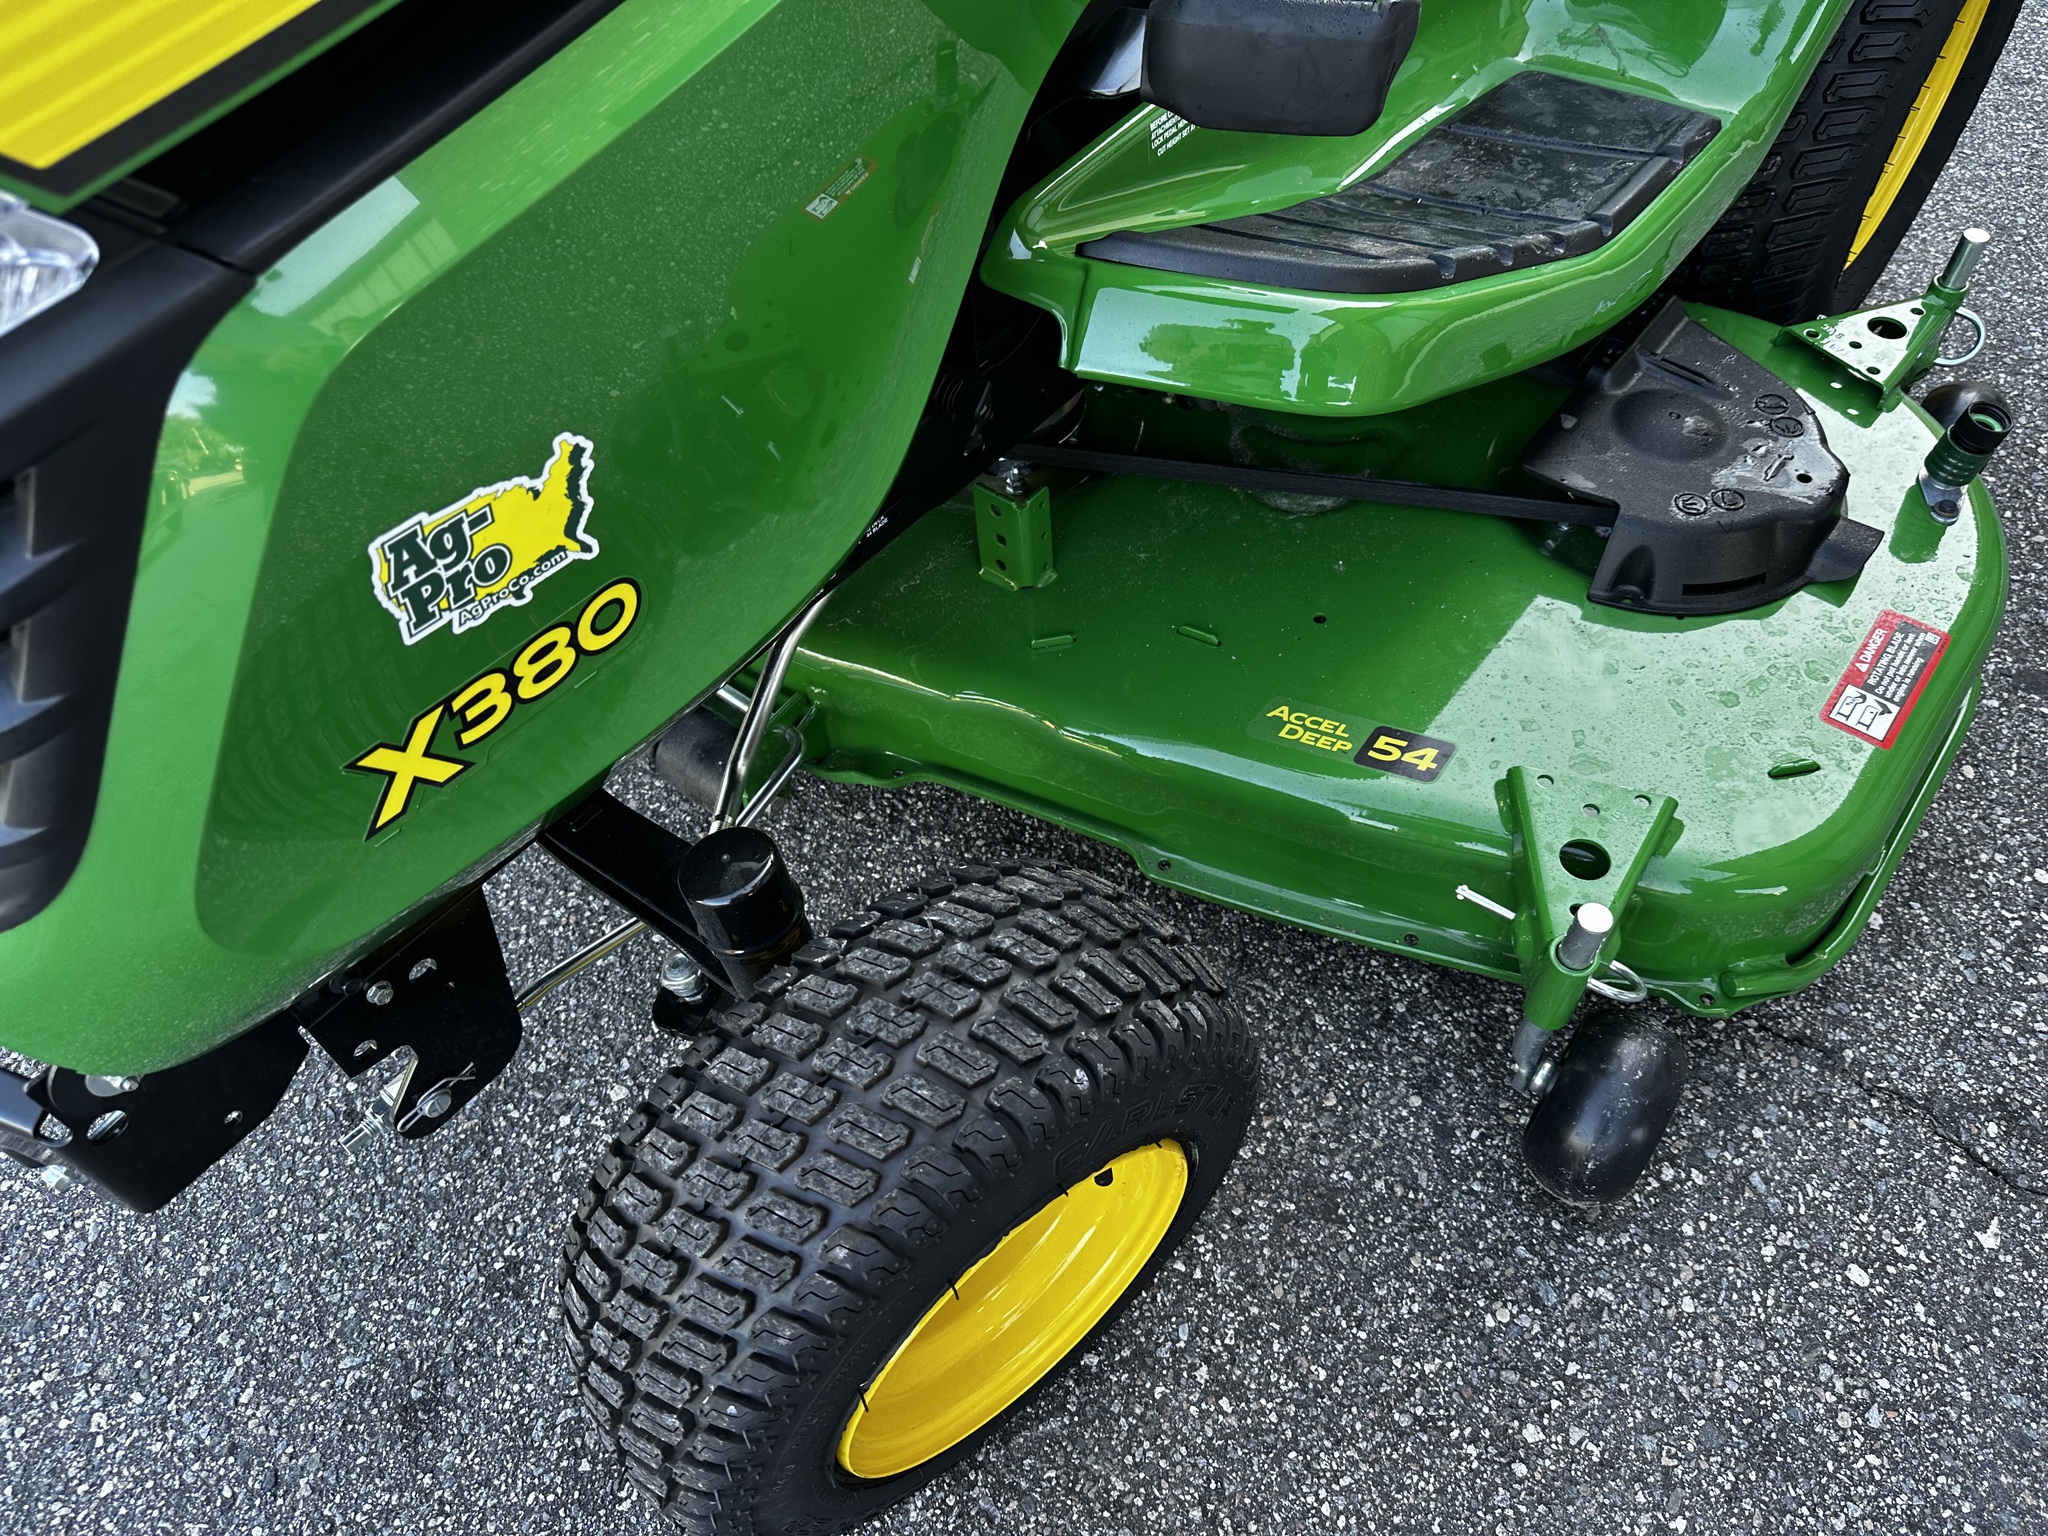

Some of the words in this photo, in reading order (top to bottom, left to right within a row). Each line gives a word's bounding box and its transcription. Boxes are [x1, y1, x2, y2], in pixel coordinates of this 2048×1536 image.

[1149, 112, 1168, 131] BEFORE
[1152, 135, 1164, 149] LOCK
[1164, 124, 1178, 140] PEDAL
[1157, 144, 1166, 156] CUT
[1166, 133, 1182, 149] HEIGHT
[1182, 127, 1190, 138] SET
[399, 544, 511, 637] Pro
[459, 550, 568, 625] AgProCo.com
[1860, 627, 1888, 665] DANGER
[1902, 643, 1909, 651] or
[1866, 652, 1892, 686] ROTATING
[1885, 631, 1905, 654] BLADE
[1890, 650, 1906, 668] hands
[1906, 657, 1925, 679] running
[1880, 675, 1891, 687] not
[1886, 665, 1897, 678] put
[1902, 677, 1911, 685] is
[1874, 685, 1886, 695] Do
[1884, 681, 1898, 698] under
[1894, 674, 1901, 682] or
[1893, 683, 1908, 703] engine
[349, 578, 642, 839] X380
[1265, 705, 1350, 738] ACCEL
[1367, 735, 1440, 772] 54
